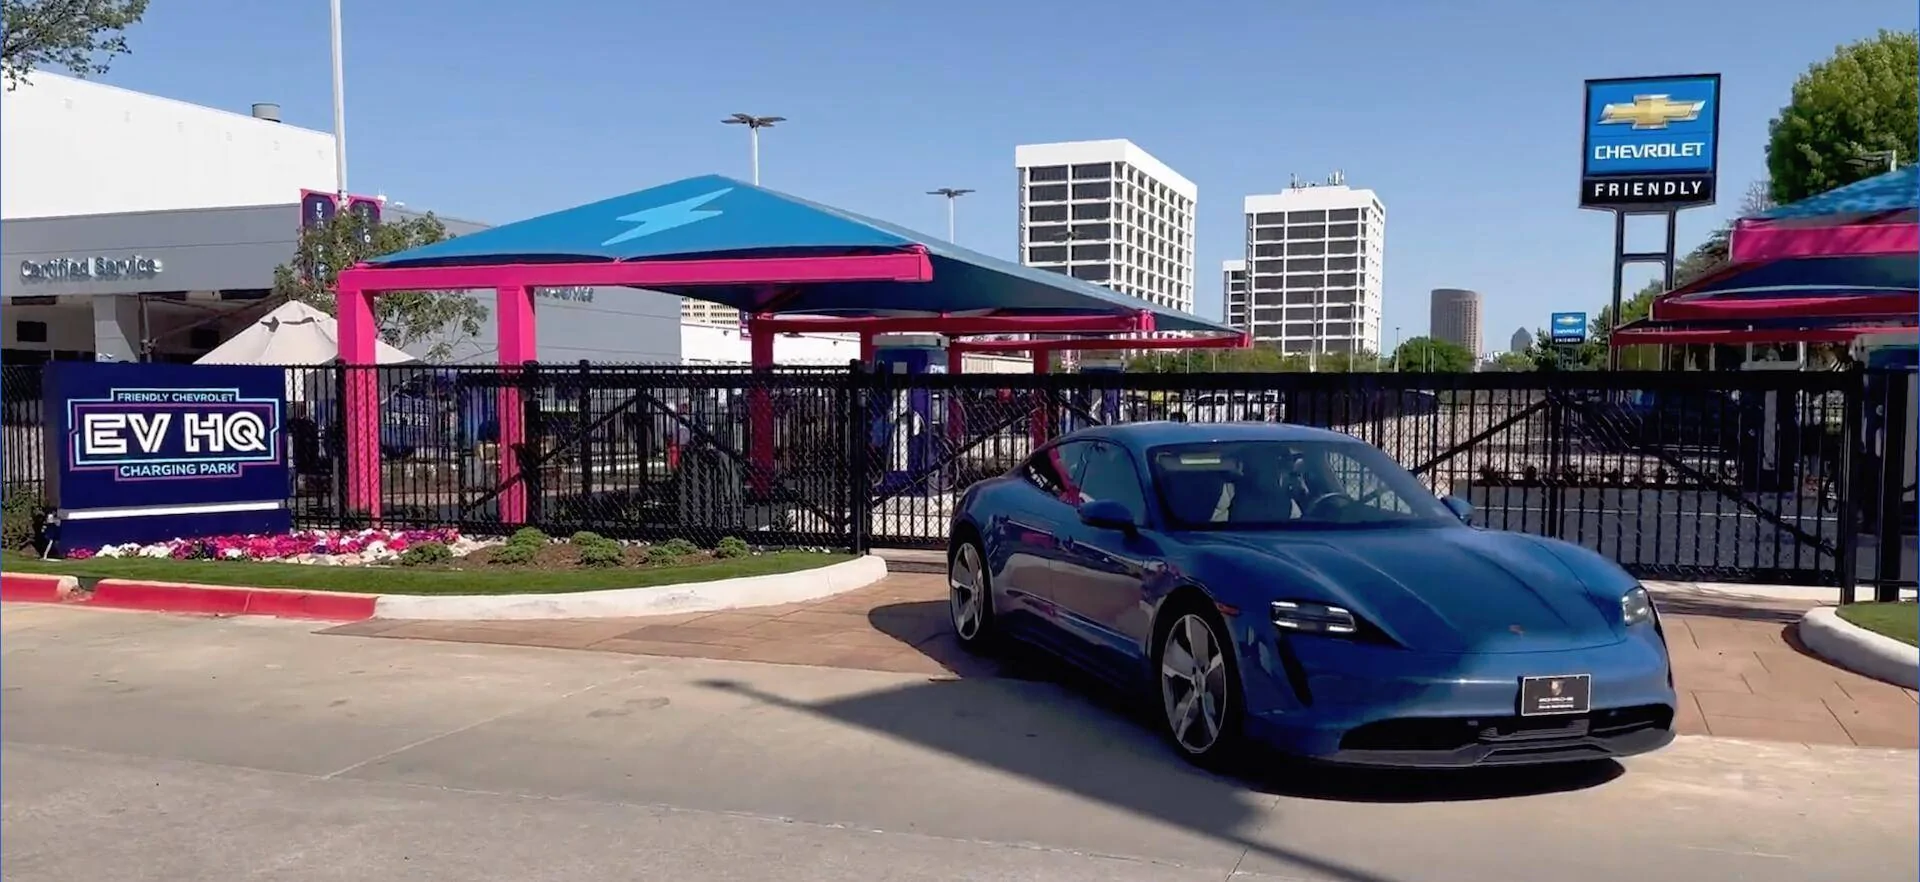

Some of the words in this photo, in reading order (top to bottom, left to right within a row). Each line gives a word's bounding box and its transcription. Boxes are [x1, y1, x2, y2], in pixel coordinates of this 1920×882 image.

[1594, 142, 1705, 160] CHEVROLET
[1594, 181, 1702, 197] FRIENDLY
[20, 257, 92, 280] Certified
[93, 254, 163, 277] Service
[117, 393, 169, 402] FRIENDLY
[172, 393, 234, 402] CHEVROLET
[84, 413, 172, 455] EV
[184, 411, 267, 453] HQ
[120, 464, 196, 477] CHARGING
[200, 463, 237, 475] PARK
